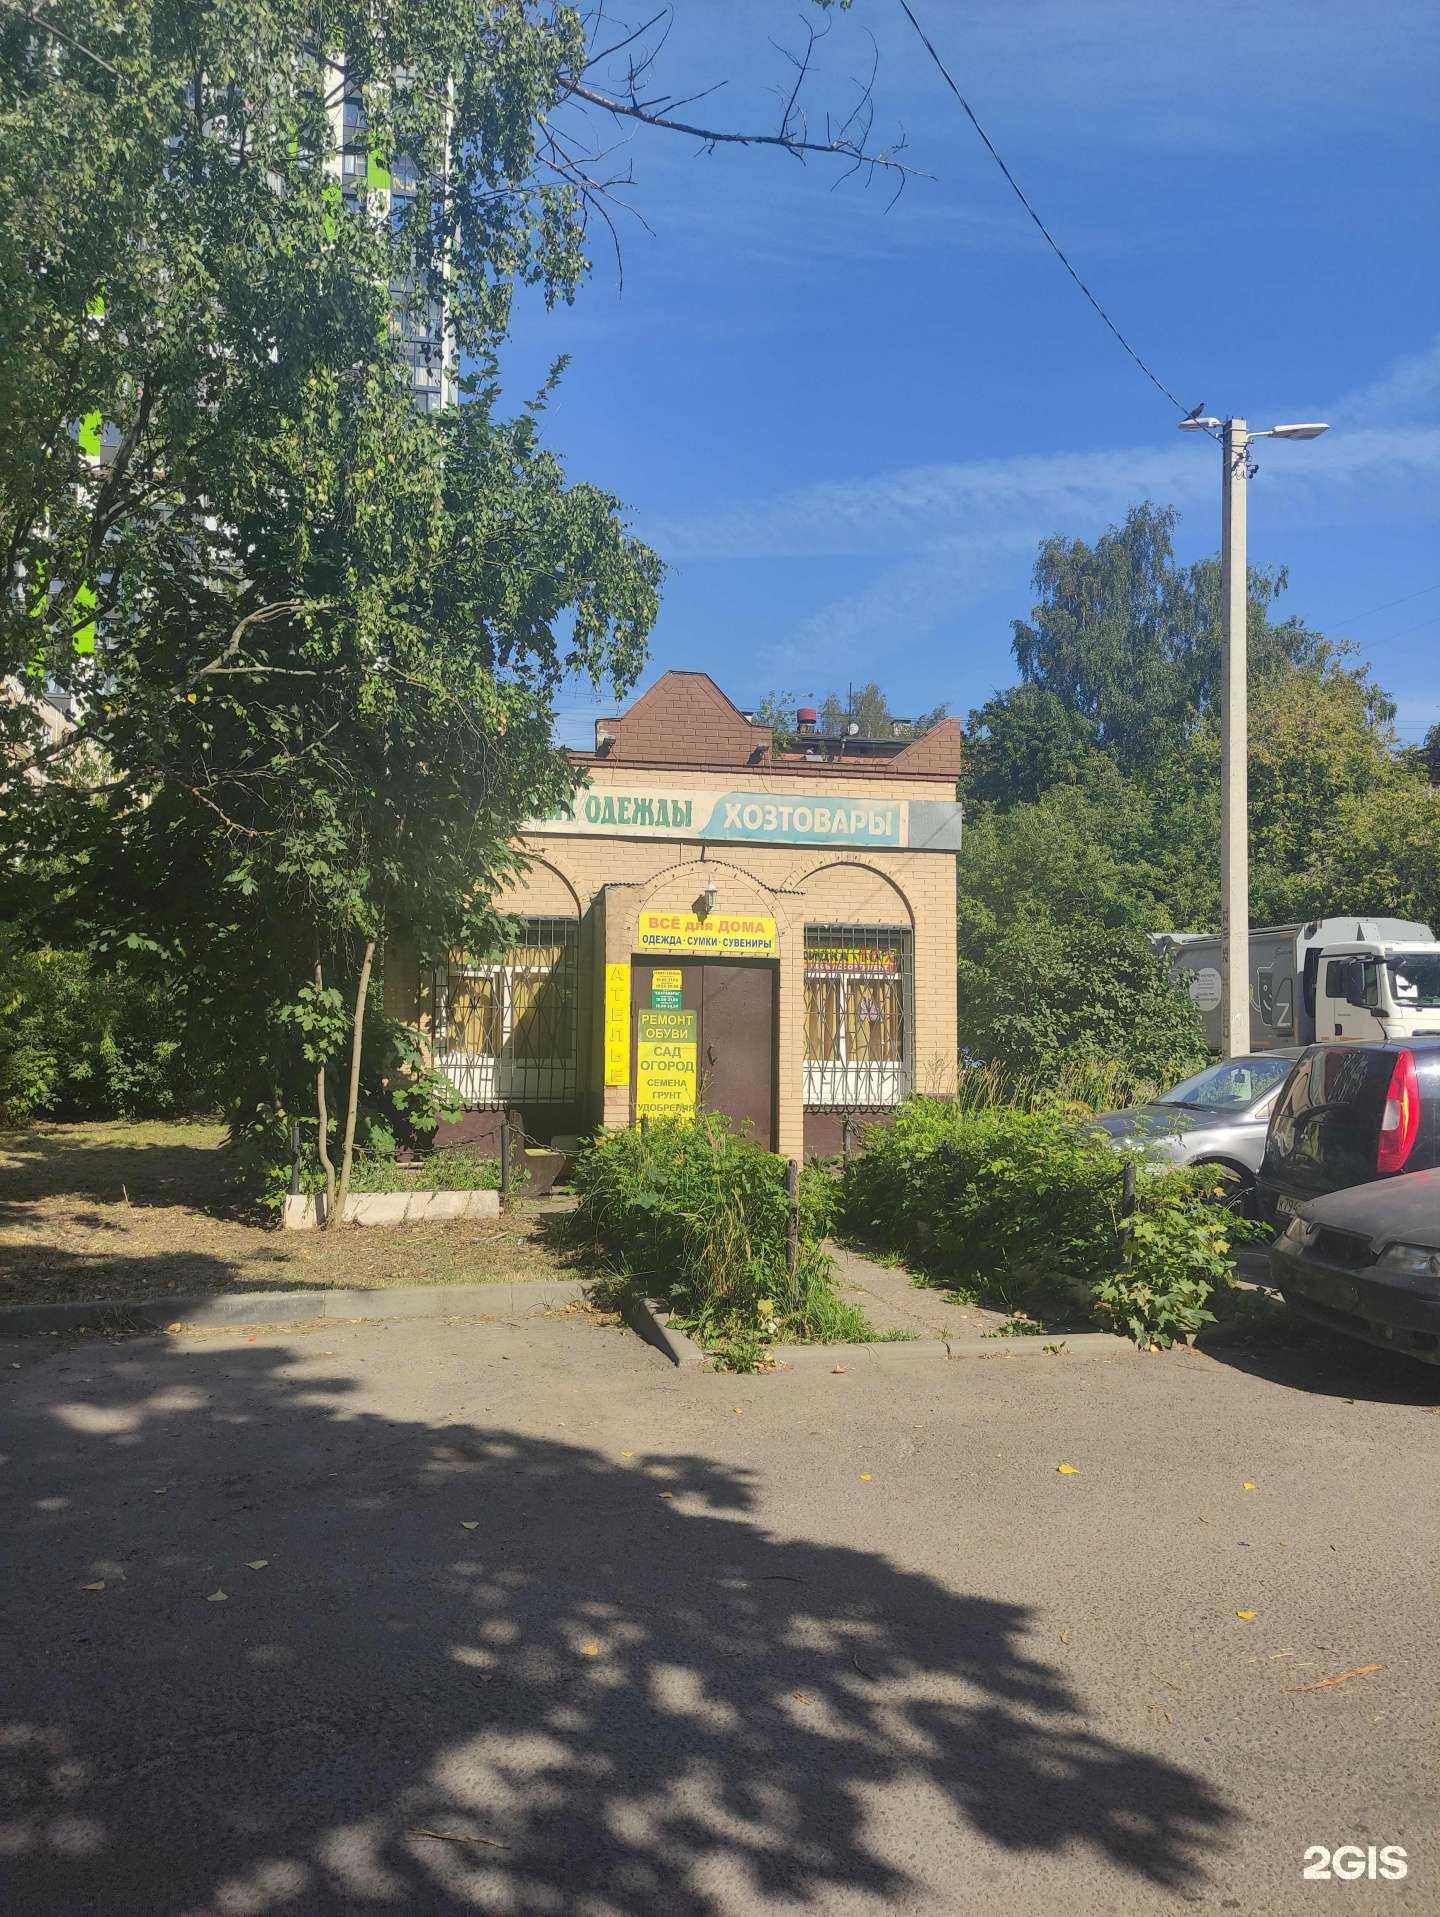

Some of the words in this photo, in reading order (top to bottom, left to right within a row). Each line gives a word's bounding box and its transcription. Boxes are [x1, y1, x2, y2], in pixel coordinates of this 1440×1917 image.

[585, 795, 692, 827] ОДЕЖДЫ
[723, 802, 892, 836] ХОЗТОВАРЫ
[648, 915, 681, 930] ВСЁ
[718, 920, 765, 934] ДОМА
[642, 934, 682, 945] ОДЕЖДА
[687, 936, 718, 947] СУМКИ
[722, 937, 772, 949] СУВЕНИРЫ
[610, 967, 625, 1083] АТЕЛЬЕ
[641, 1014, 694, 1026] РЕМОНТ
[646, 1028, 688, 1039] ОБУВИ
[653, 1046, 682, 1058] САД
[640, 1061, 695, 1073] ОГОРОД
[647, 1079, 687, 1087] СЕМЕНА
[652, 1091, 682, 1099] ГРУНТ
